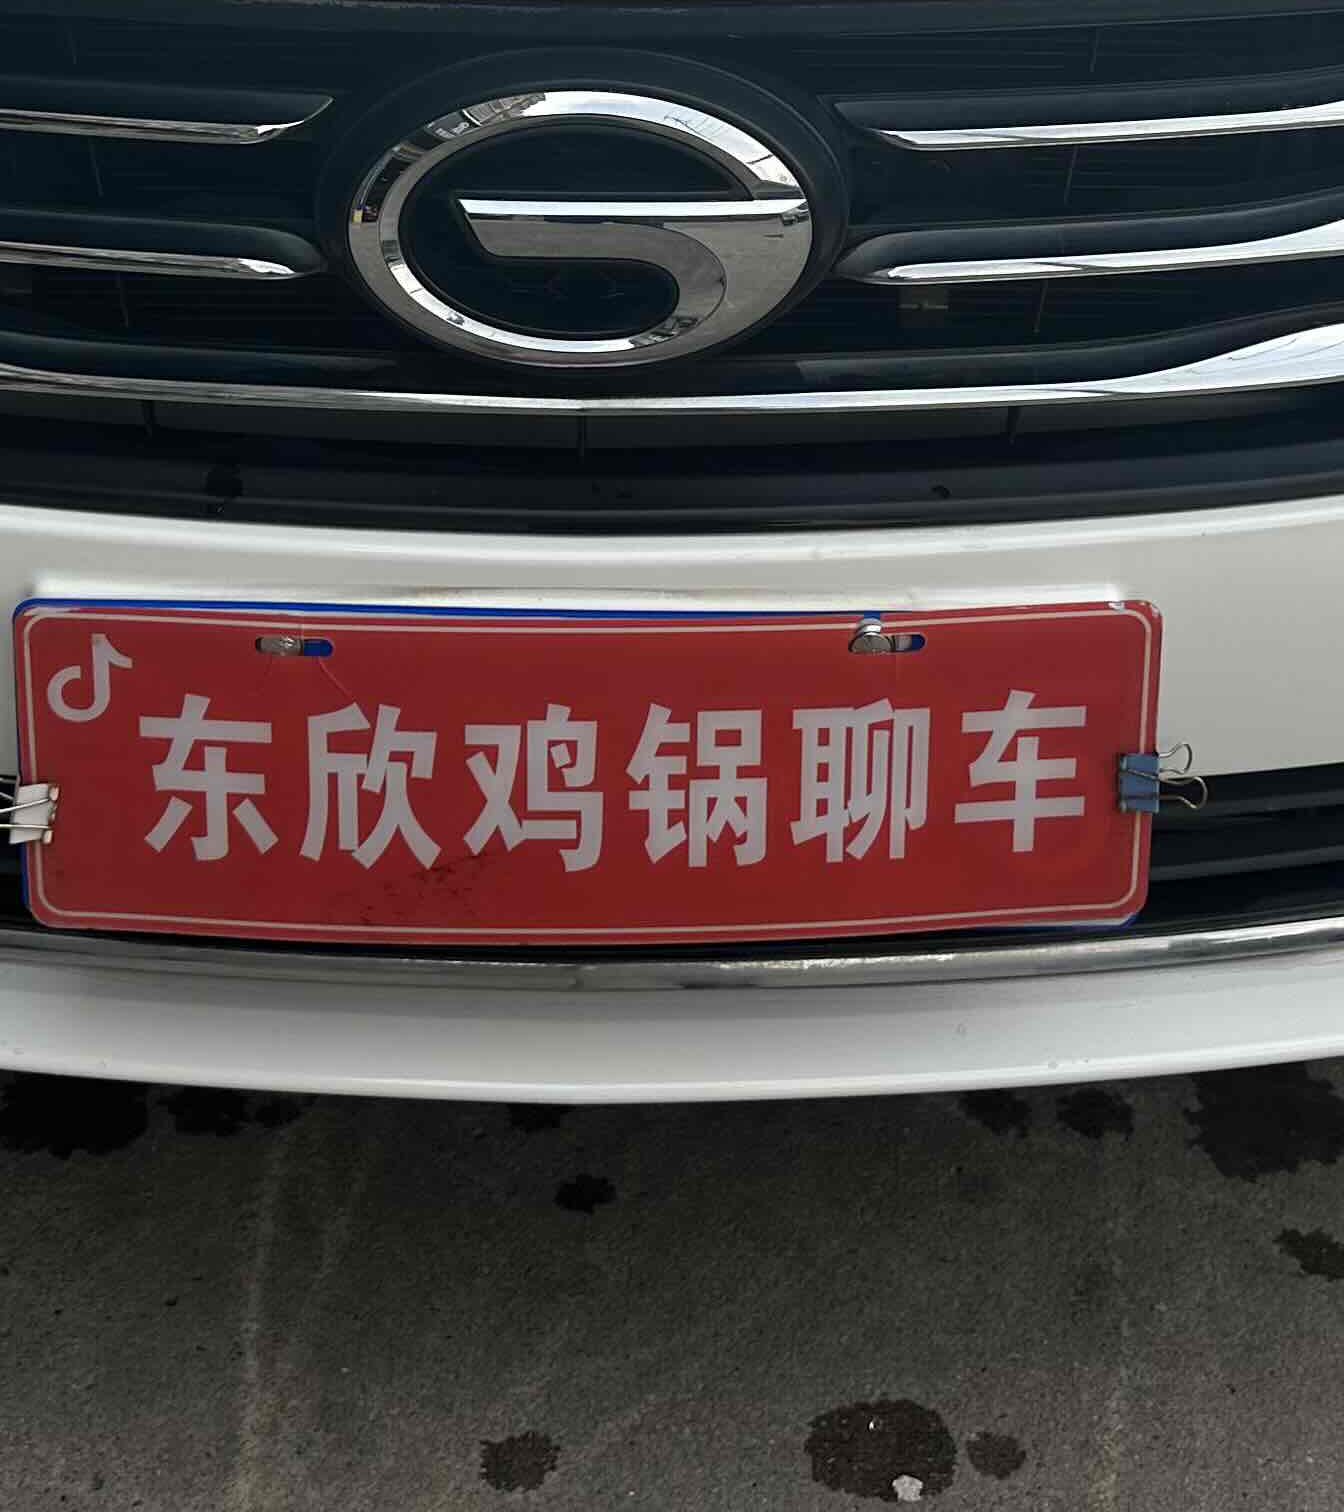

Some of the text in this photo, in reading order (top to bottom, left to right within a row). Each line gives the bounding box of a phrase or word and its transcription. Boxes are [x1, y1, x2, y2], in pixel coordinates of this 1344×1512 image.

[138, 689, 1089, 872] 东欣鸡锅聊车
